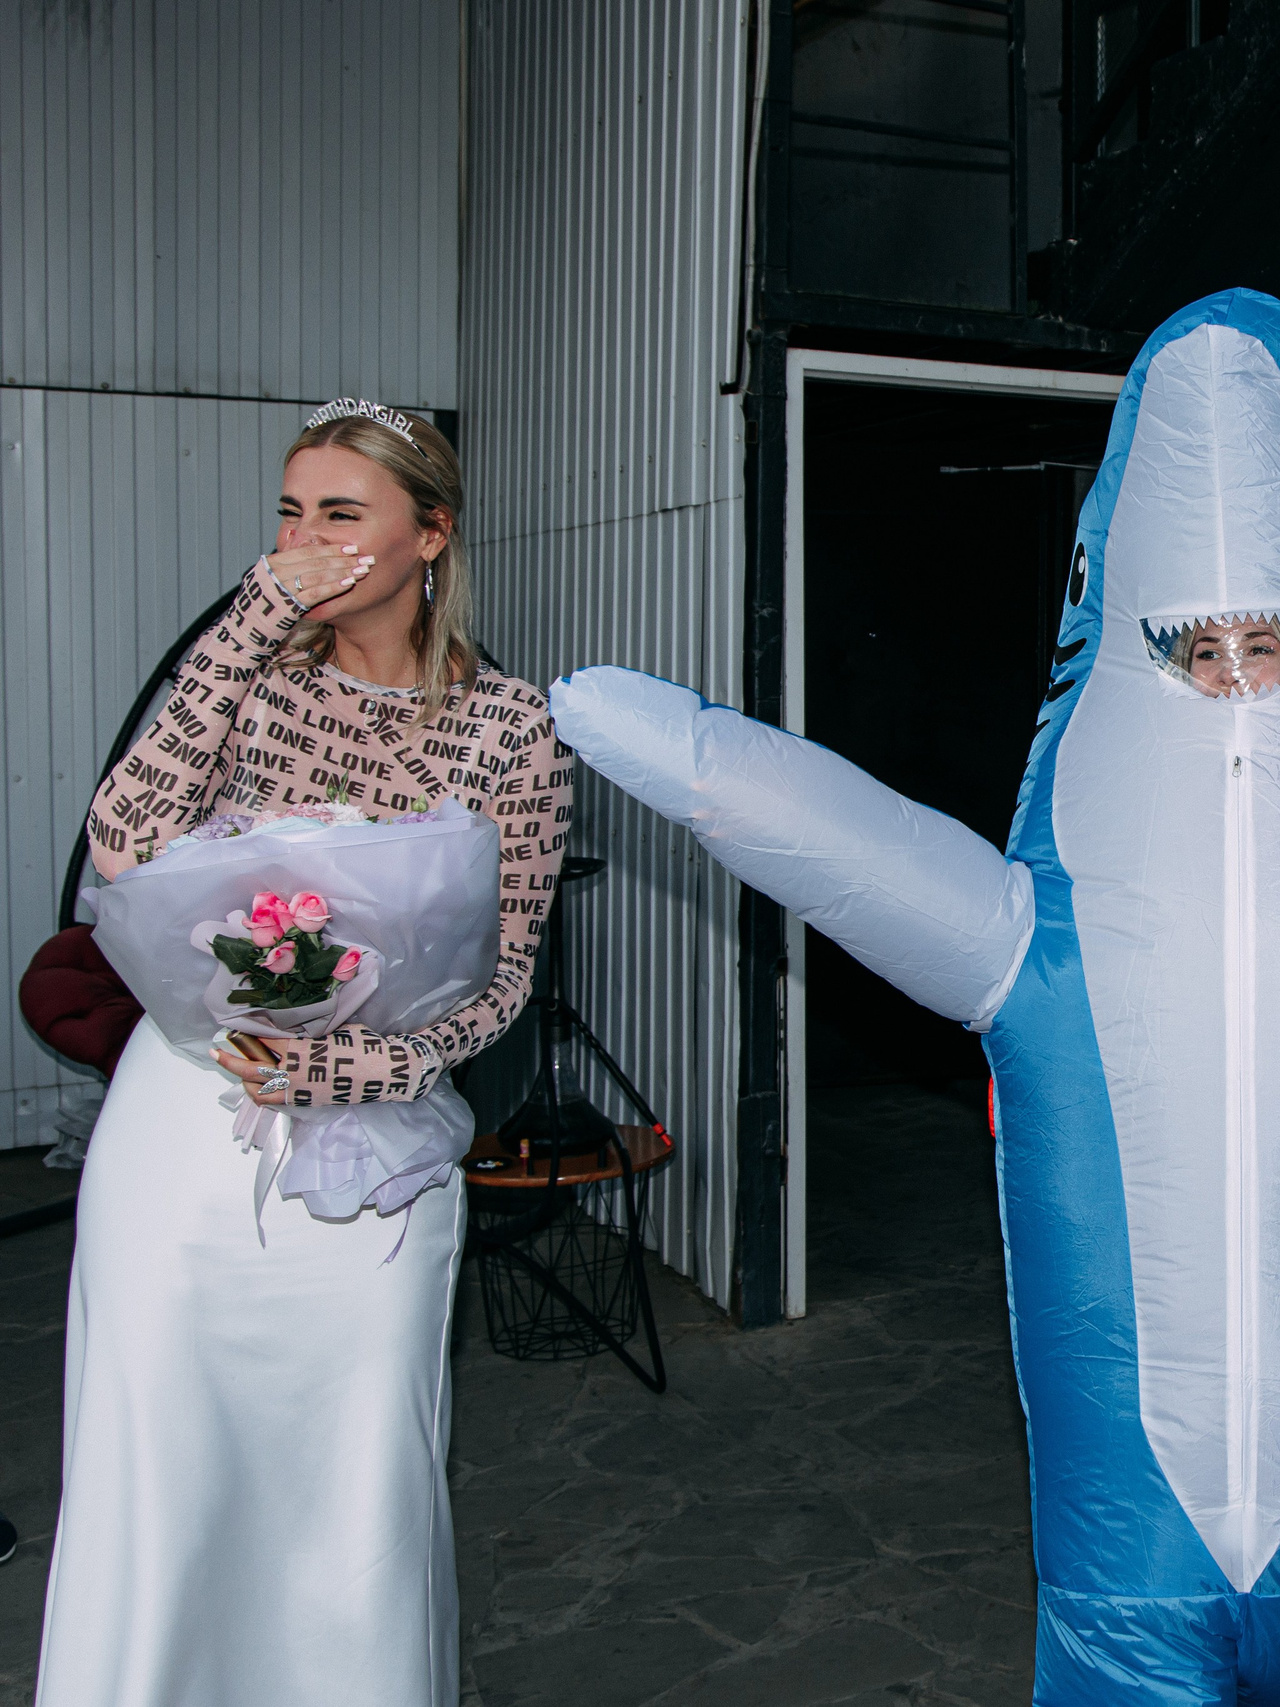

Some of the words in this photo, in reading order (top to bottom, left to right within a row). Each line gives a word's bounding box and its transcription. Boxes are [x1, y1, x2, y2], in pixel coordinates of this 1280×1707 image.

[214, 664, 257, 683] NE
[475, 680, 508, 698] NE
[167, 696, 208, 740] ONE
[253, 682, 298, 718] ONE
[302, 708, 372, 746] LOVE
[358, 698, 416, 725] ONE
[467, 701, 529, 730] LOVE
[157, 732, 211, 770] ONE
[266, 721, 318, 756] ONE
[323, 745, 395, 782] LOVE
[422, 738, 472, 763] ONE
[124, 755, 179, 793] ONE
[232, 764, 279, 798] ONE
[236, 744, 297, 776] LOVE
[309, 767, 366, 799] ONE
[373, 788, 417, 812] LO
[393, 745, 449, 801] LOVE
[448, 767, 492, 794] ONE
[220, 779, 269, 813] LOVE
[496, 795, 553, 817] ONE
[89, 808, 127, 853] ONE
[503, 821, 541, 839] LO
[331, 1057, 355, 1106] LOV
[386, 1041, 410, 1096] OVE
